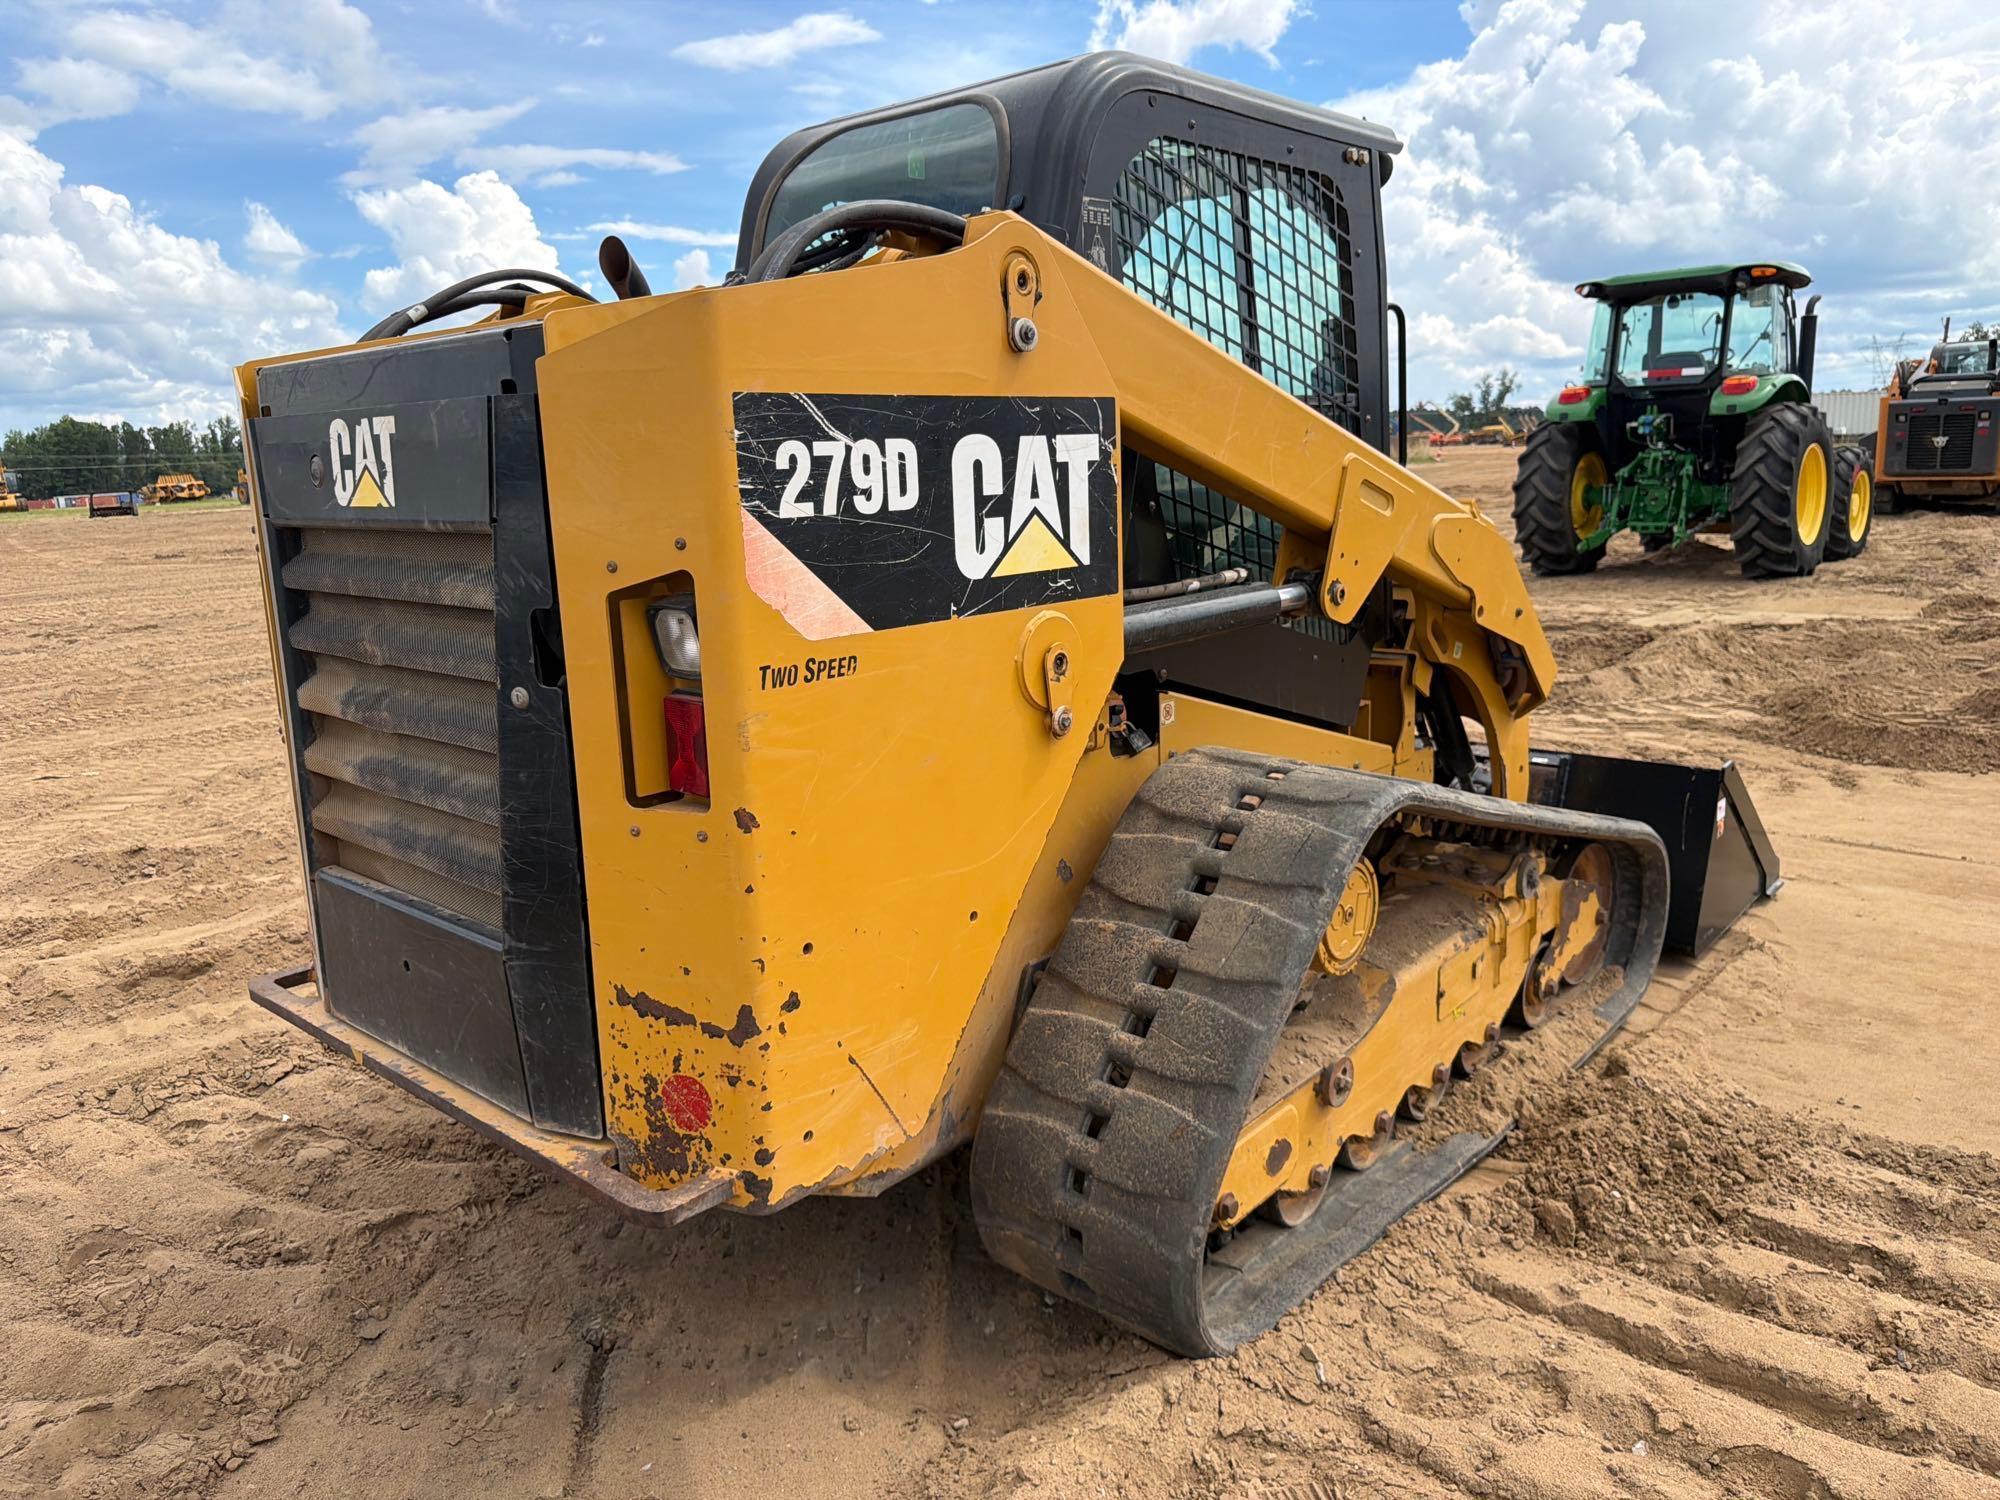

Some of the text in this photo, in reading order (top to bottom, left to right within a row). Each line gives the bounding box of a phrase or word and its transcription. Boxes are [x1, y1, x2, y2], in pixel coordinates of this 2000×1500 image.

[329, 415, 395, 507] CAT
[775, 438, 919, 518] 279D
[951, 433, 1100, 580] CAT
